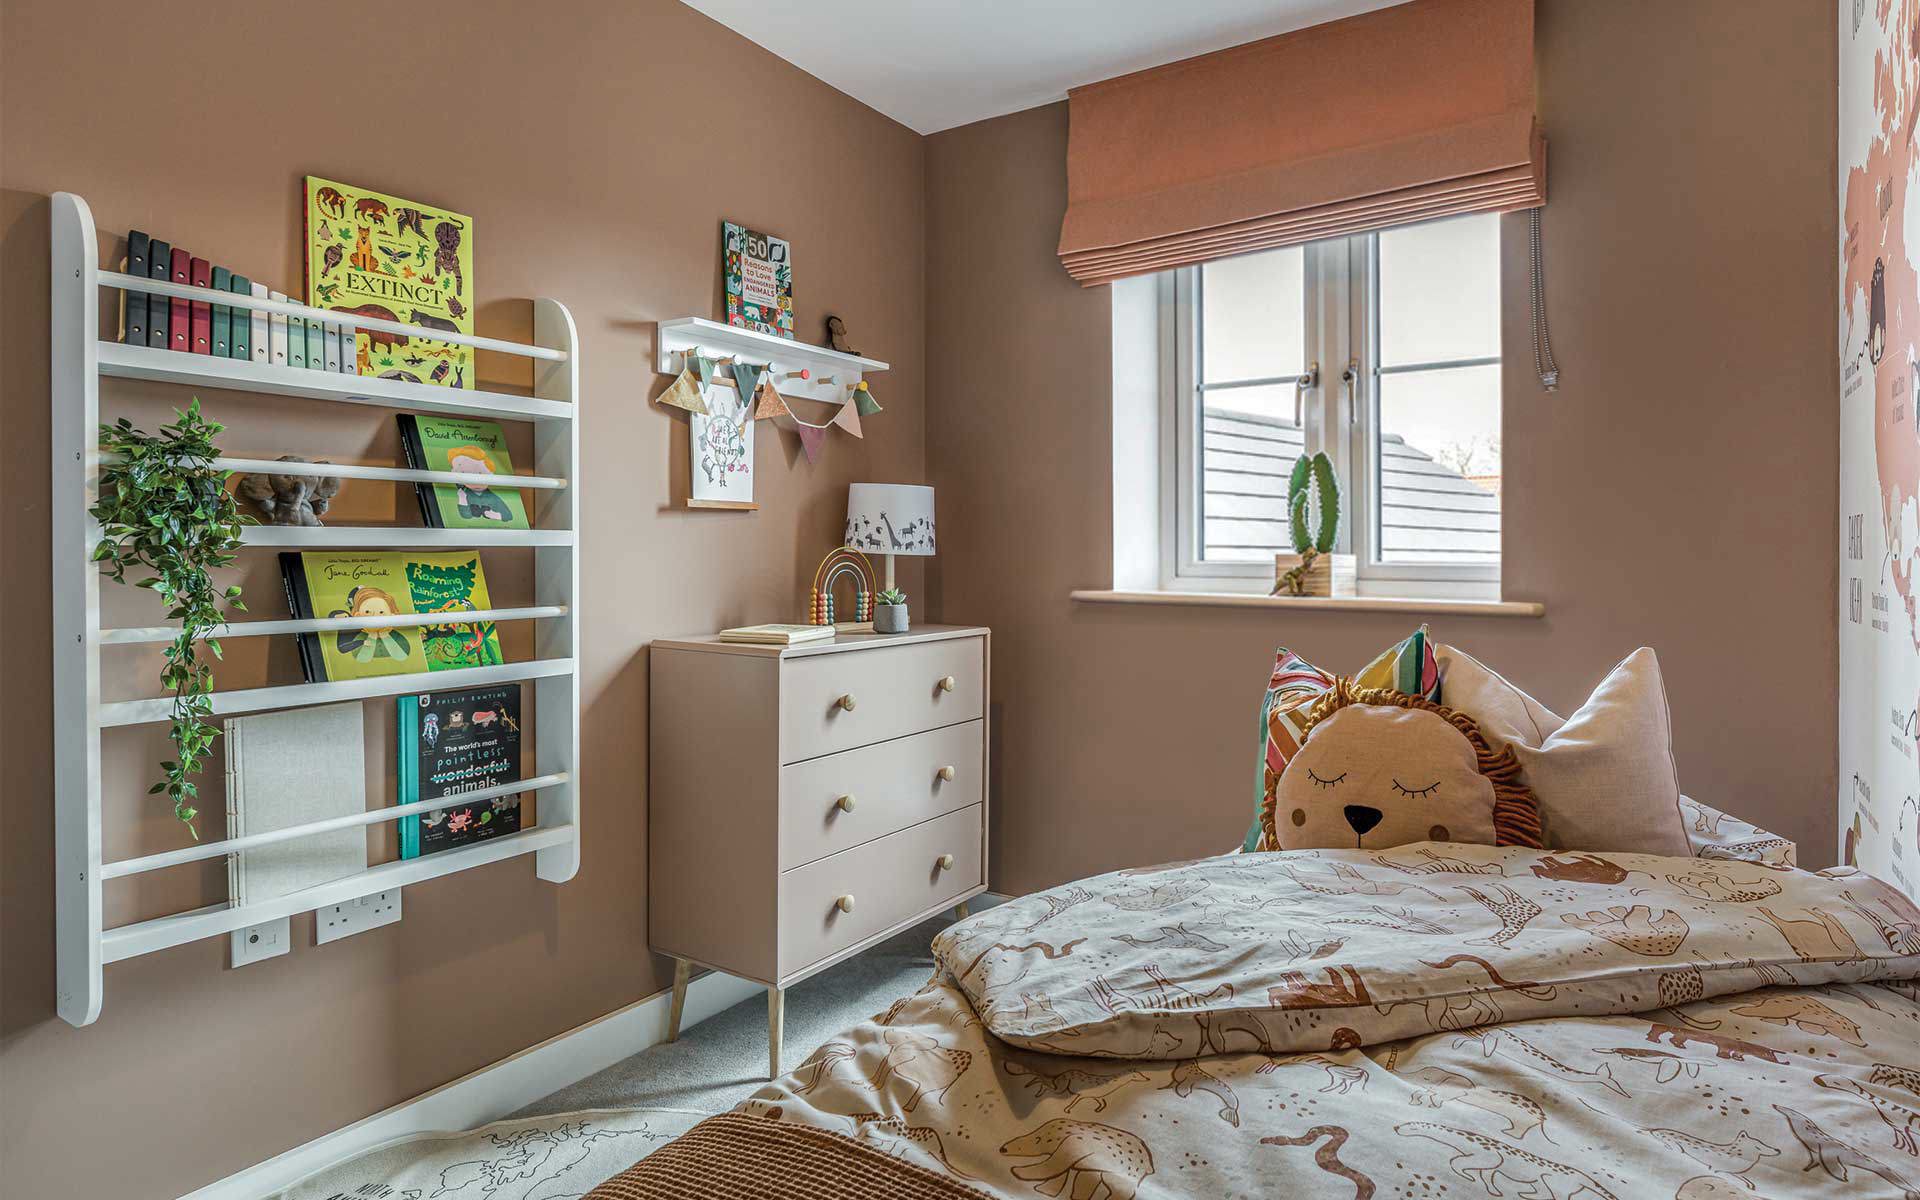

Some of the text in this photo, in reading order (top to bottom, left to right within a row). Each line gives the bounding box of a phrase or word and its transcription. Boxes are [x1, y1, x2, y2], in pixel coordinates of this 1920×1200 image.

[748, 236, 767, 259] 50
[744, 258, 773, 274] Reasons
[746, 268, 772, 281] to Love
[346, 272, 443, 305] EXTINCT
[745, 284, 775, 298] ANIMALS
[424, 427, 450, 440] David
[324, 564, 390, 580] Jane Goodall
[413, 567, 464, 591] Roaming
[409, 581, 460, 598] Rainforest
[458, 741, 481, 751] world's
[482, 739, 498, 747] most
[437, 748, 501, 771] pointless
[432, 758, 509, 784] wonderful
[355, 1183, 395, 1199] NORTH
